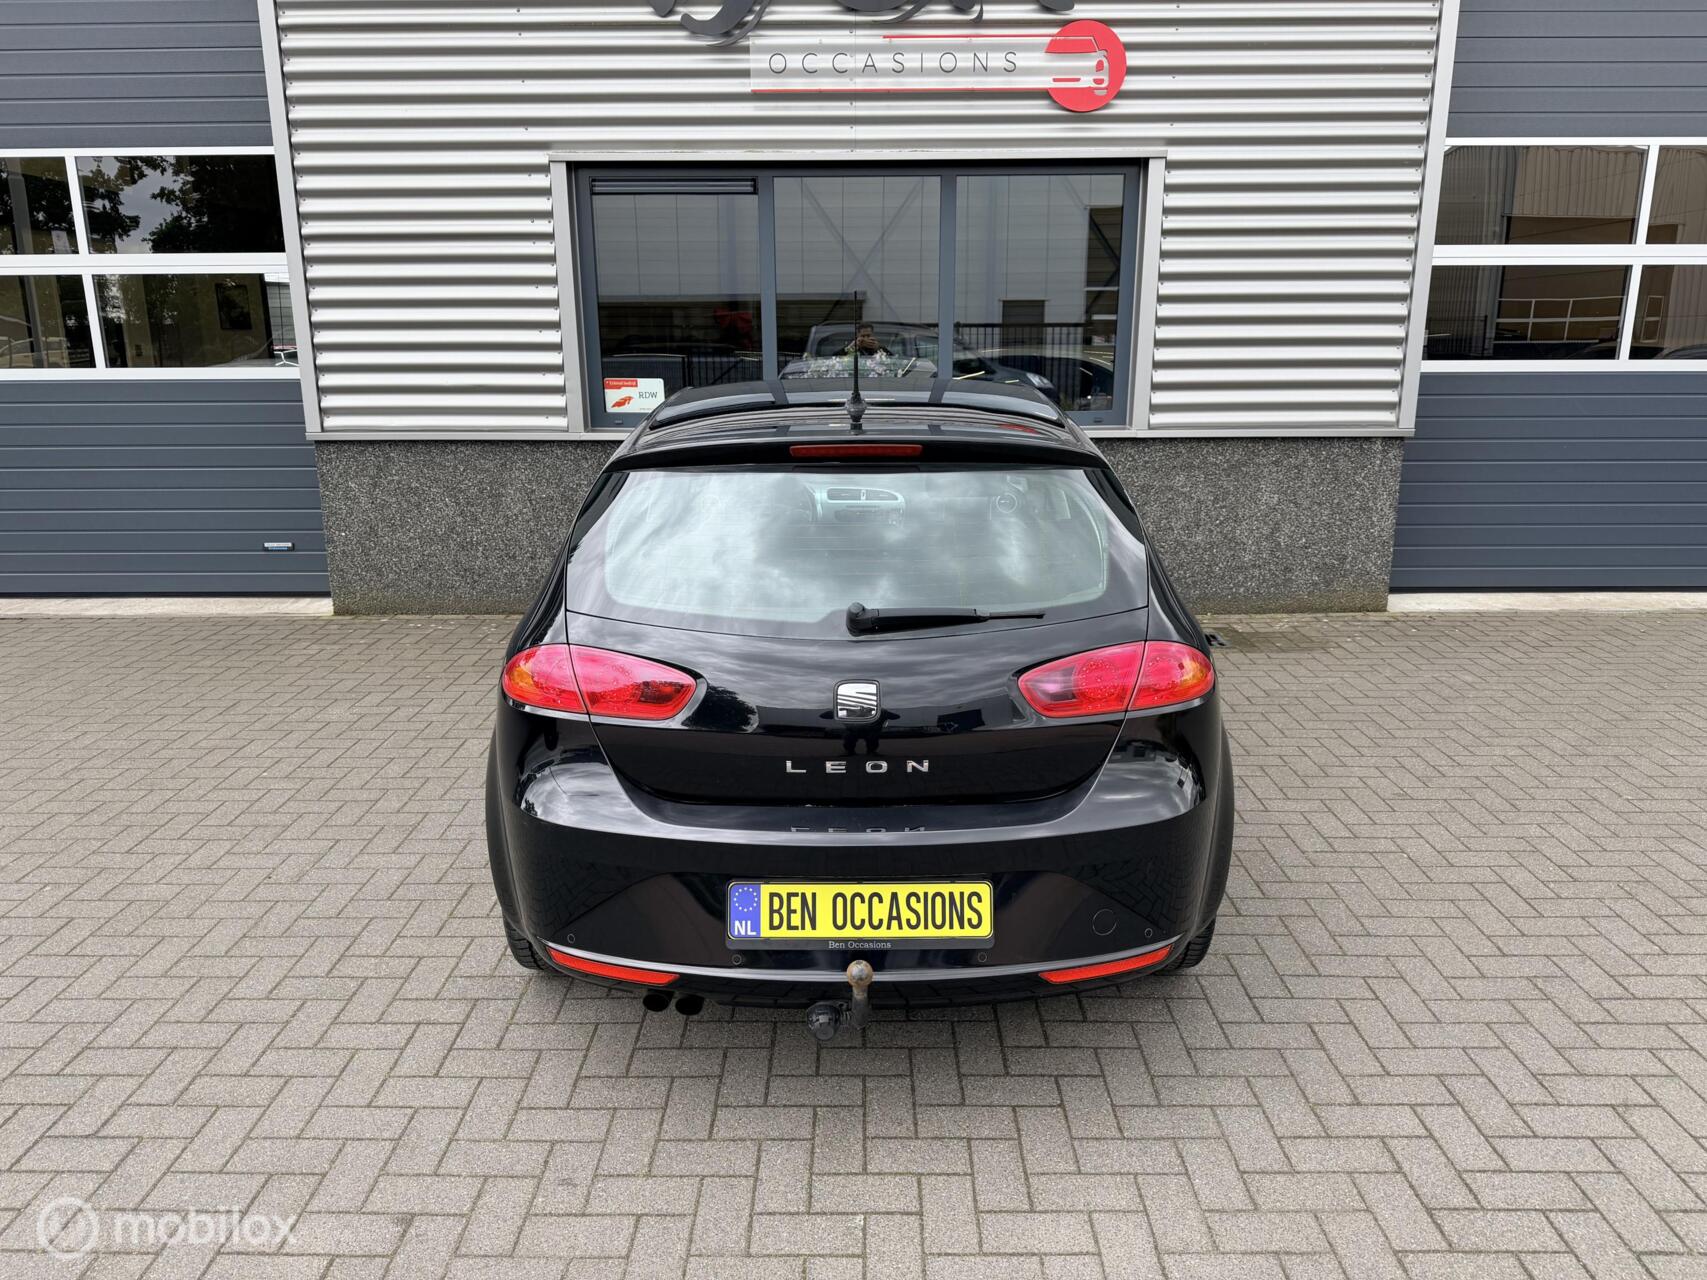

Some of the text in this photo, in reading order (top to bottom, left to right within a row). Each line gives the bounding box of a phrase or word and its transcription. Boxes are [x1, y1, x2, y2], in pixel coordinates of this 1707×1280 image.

[768, 51, 1018, 75] OCCASIONS
[638, 391, 657, 399] RDW
[785, 759, 930, 774] LEON
[768, 891, 983, 931] BEN OCCASIONS
[734, 920, 757, 936] NL
[828, 941, 892, 949] Ben Occasions
